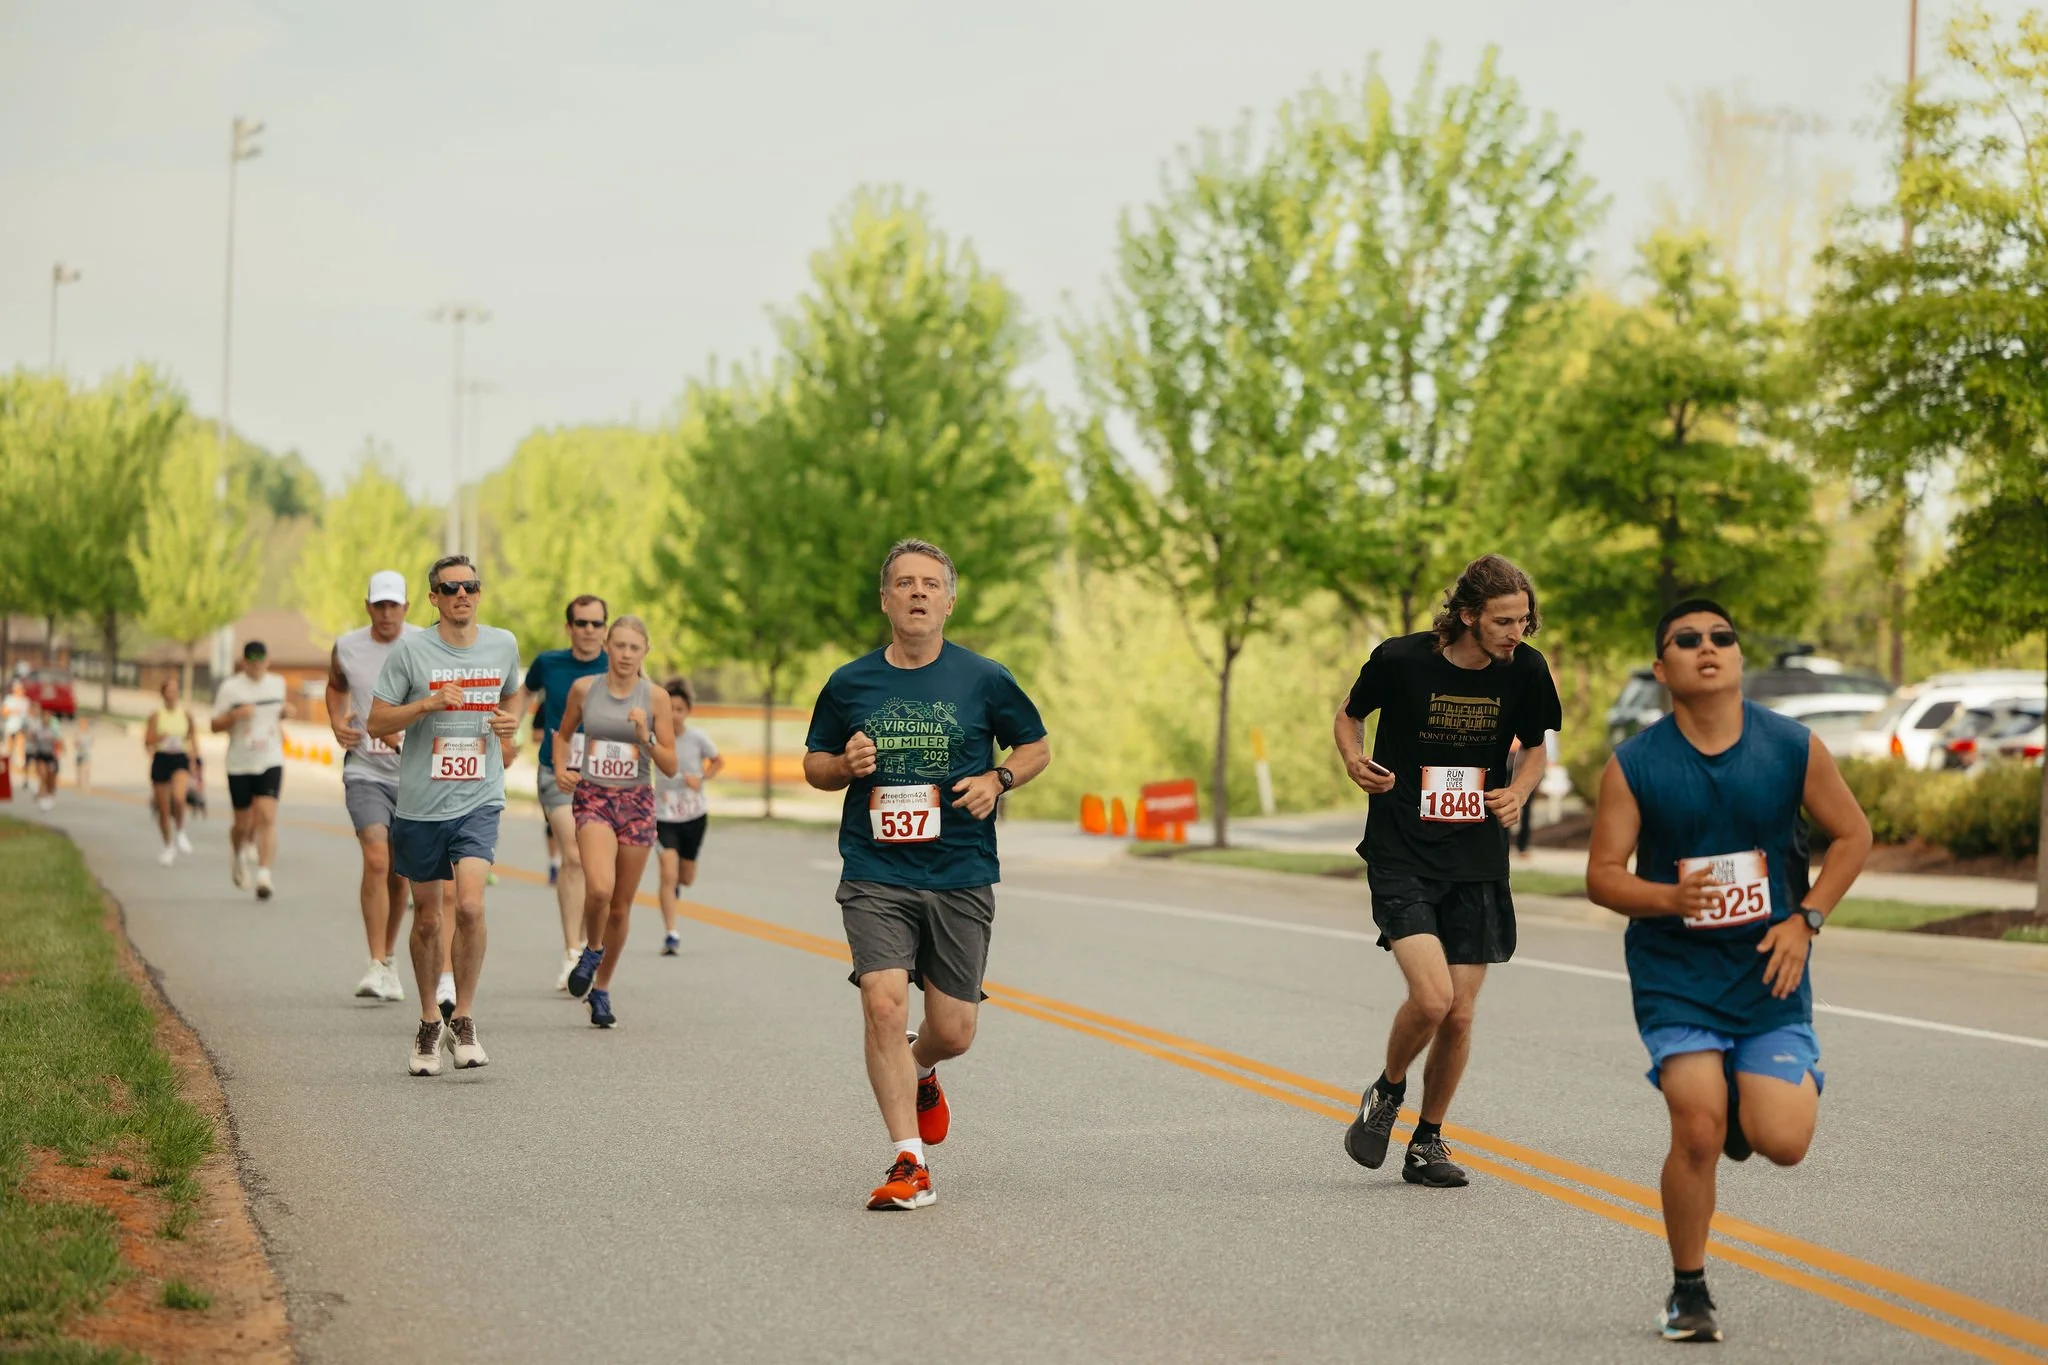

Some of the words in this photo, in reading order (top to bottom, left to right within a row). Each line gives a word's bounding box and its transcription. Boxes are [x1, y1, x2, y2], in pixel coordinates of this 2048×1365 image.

[431, 668, 501, 682] PREVENT
[431, 691, 500, 704] TECT
[883, 721, 944, 735] VIRGINIA
[882, 738, 895, 749] 10
[901, 737, 945, 748] MILER
[1419, 731, 1444, 741] POINT
[1458, 734, 1488, 743] HONOR
[923, 750, 949, 762] 2023
[441, 756, 478, 777] 530
[591, 758, 635, 777] 1802
[882, 791, 927, 799] freedom424
[1426, 792, 1481, 817] 1848
[881, 810, 929, 838] 537
